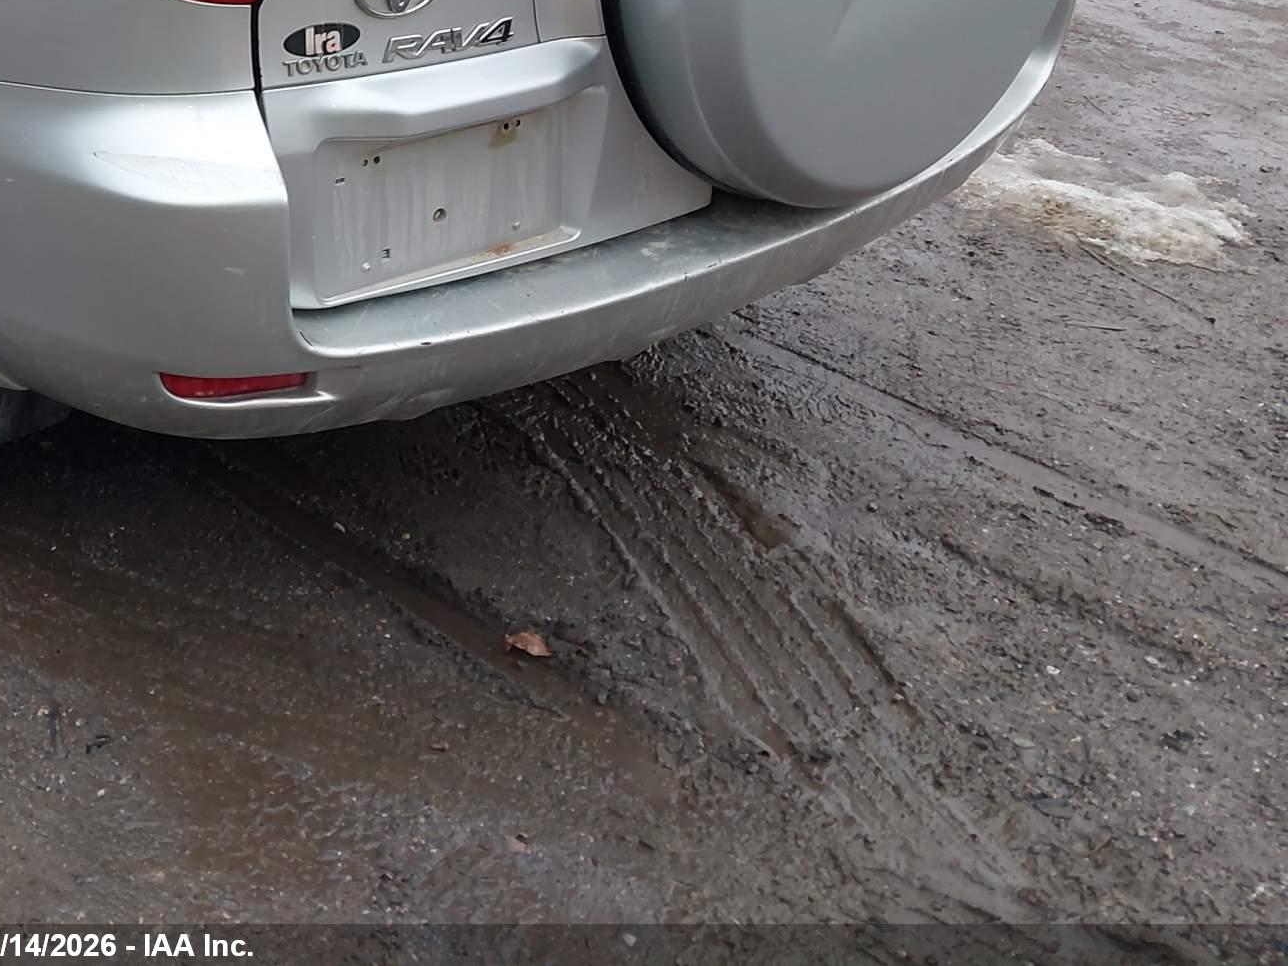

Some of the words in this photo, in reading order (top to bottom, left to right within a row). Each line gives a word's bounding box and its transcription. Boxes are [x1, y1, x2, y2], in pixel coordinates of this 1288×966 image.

[304, 26, 341, 57] Ira
[382, 16, 514, 63] RAV4
[282, 50, 368, 77] TOYOTA
